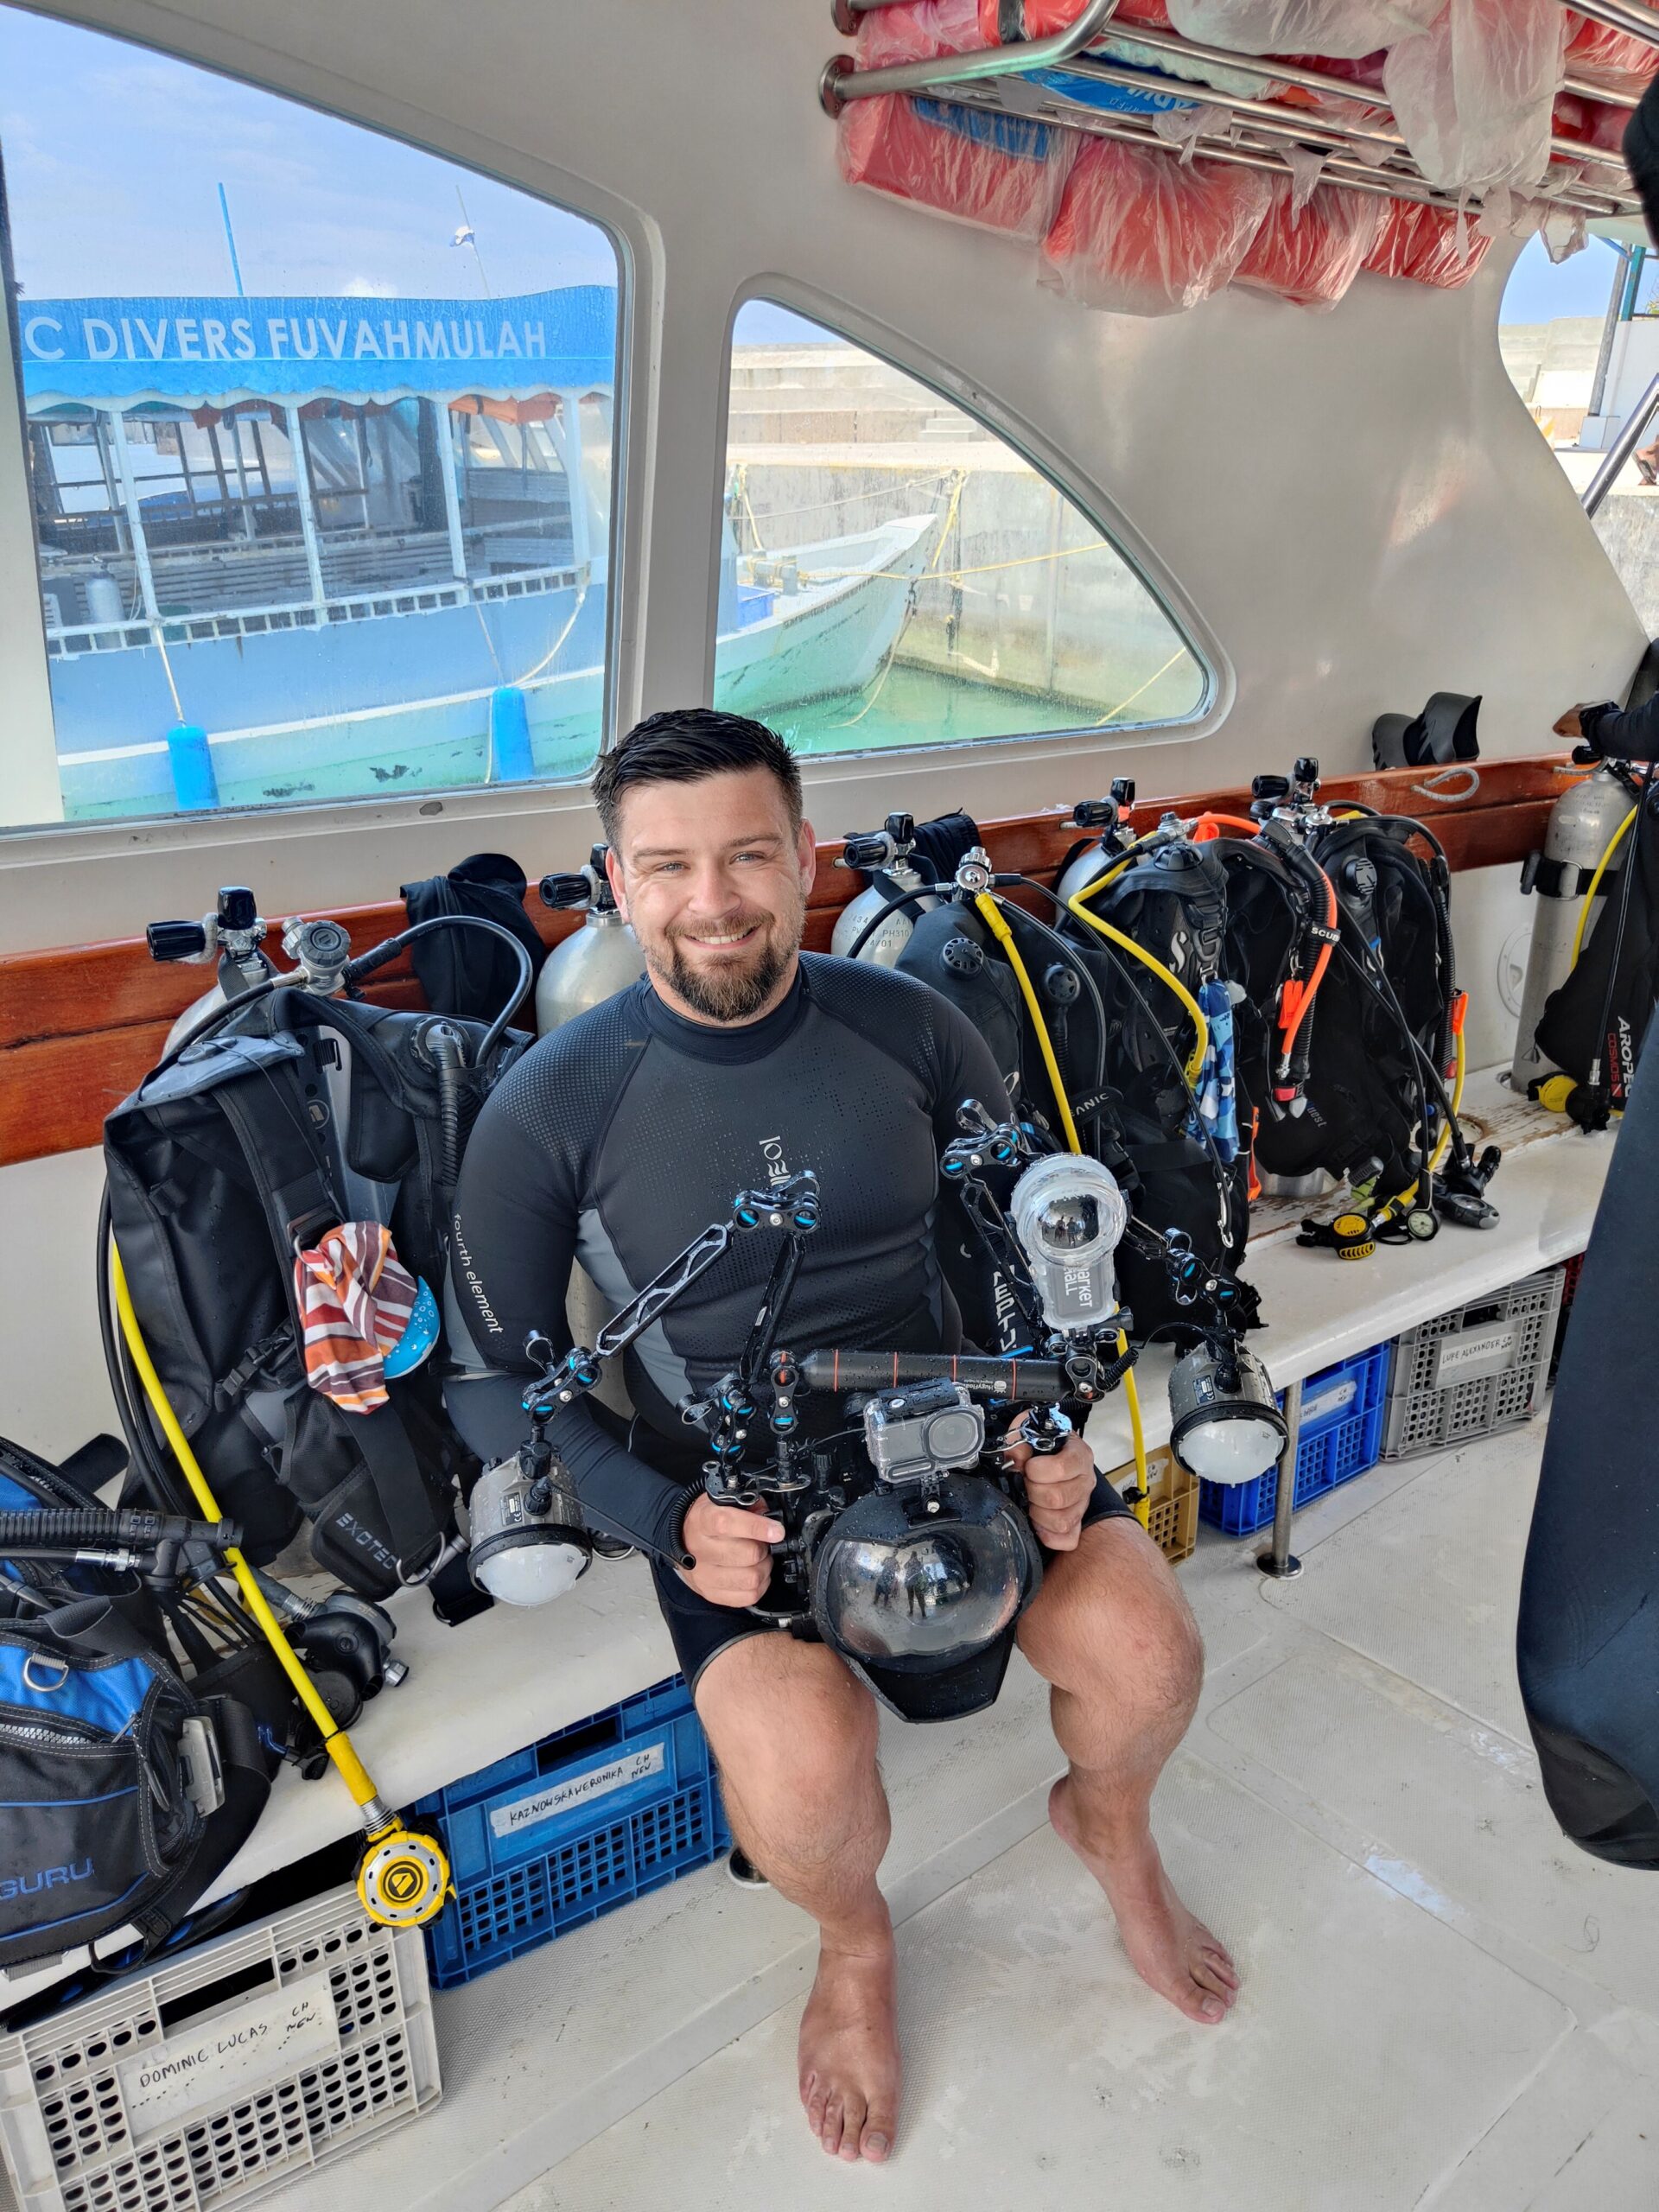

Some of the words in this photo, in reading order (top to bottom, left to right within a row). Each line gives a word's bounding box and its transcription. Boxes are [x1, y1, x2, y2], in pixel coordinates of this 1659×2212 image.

[83, 317, 257, 360] DIVERS
[267, 317, 546, 360] FUVAHMULAH
[1607, 1033, 1620, 1083] COSMOS
[454, 1212, 473, 1267] fourth
[466, 1270, 505, 1333] element
[335, 1512, 397, 1570] EXOTEC
[0, 1856, 93, 1901] GURU
[139, 2048, 209, 2088] DOMINIC
[217, 2023, 269, 2055] LUCAS
[291, 2001, 309, 2018] CH
